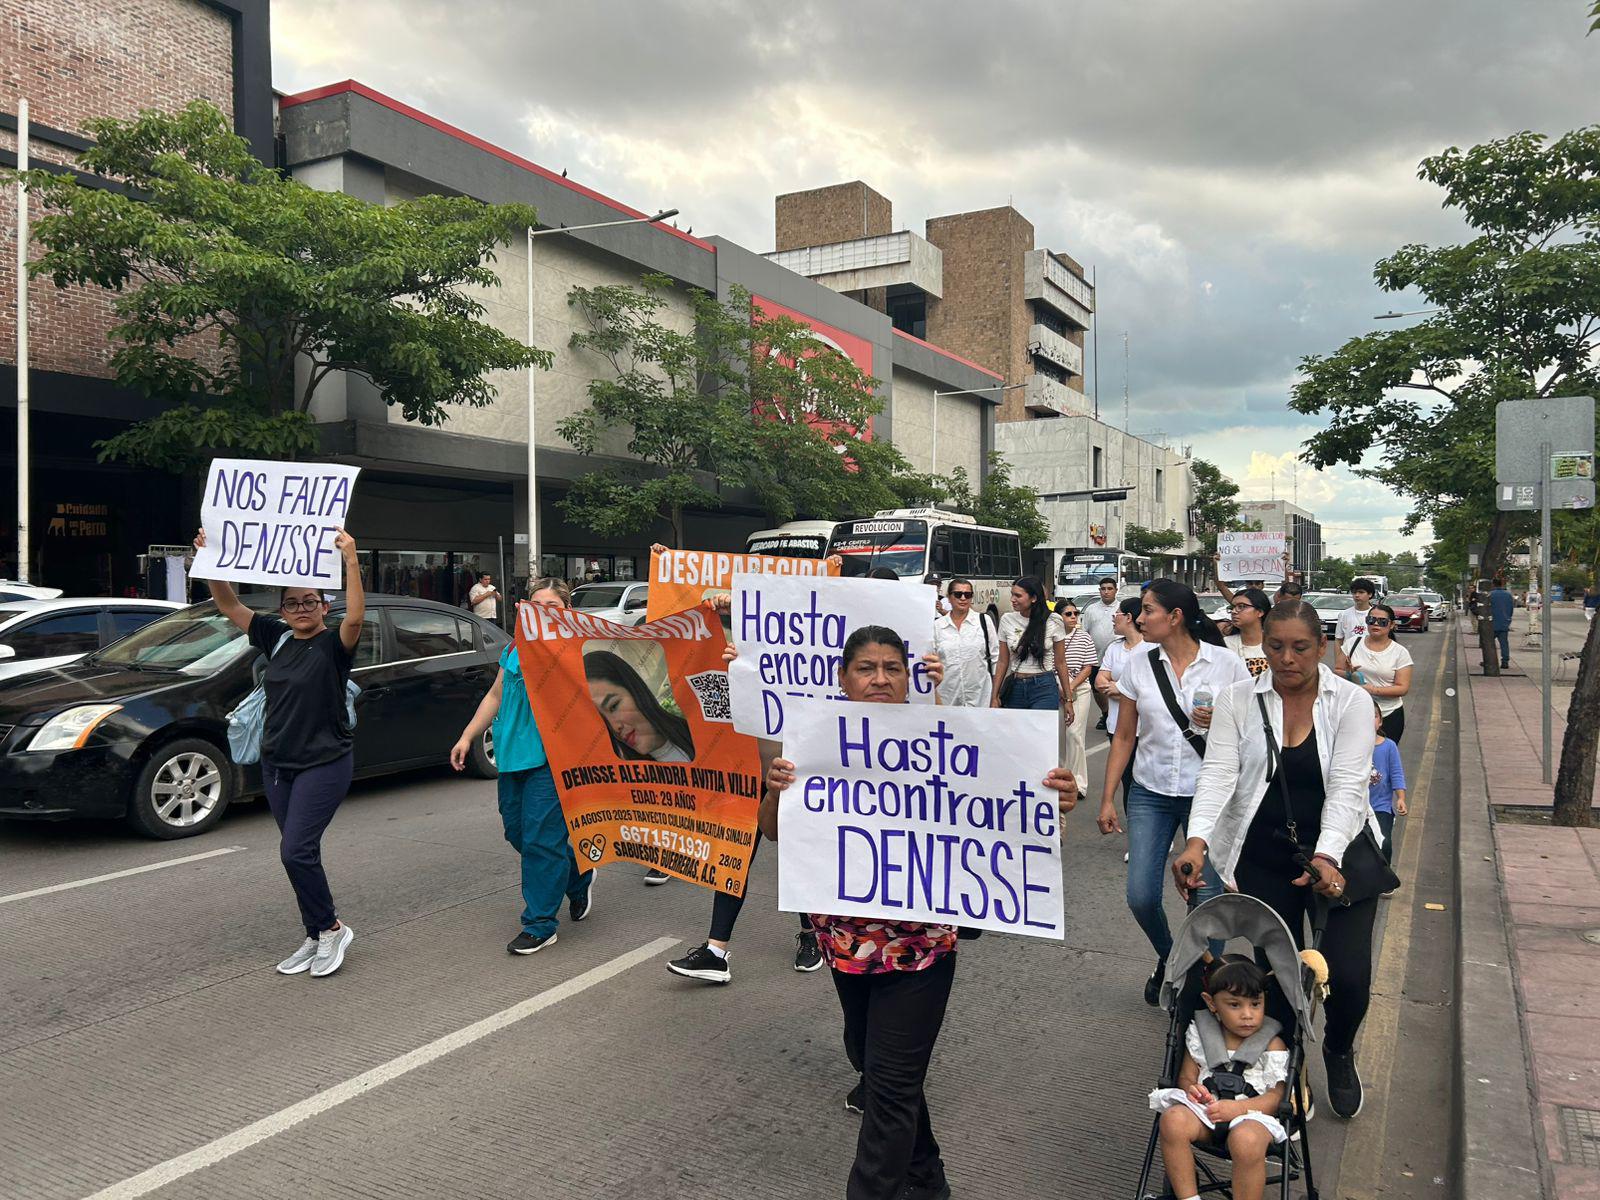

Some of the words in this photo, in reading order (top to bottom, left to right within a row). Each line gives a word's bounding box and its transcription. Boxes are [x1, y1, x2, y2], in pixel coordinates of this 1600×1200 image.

[212, 469, 267, 511] NOS
[277, 475, 349, 519] FALTA
[788, 539, 819, 550] ABASTOS
[854, 523, 902, 533] REVOLUCION
[216, 520, 337, 578] DENISSE
[1223, 562, 1232, 572] SE
[1238, 558, 1285, 573] BUSCAN
[520, 602, 713, 641] DESAPARECIDA
[741, 590, 847, 649] Hasta
[838, 715, 979, 778] Hasta
[561, 765, 618, 790] DENISSE
[618, 764, 689, 787] ALEJANDRA
[690, 767, 726, 793] AVITIA
[727, 772, 758, 799] VILLA
[630, 789, 660, 806] EDAD:
[660, 790, 673, 807] 29
[674, 789, 696, 811] AÑOS
[803, 774, 1055, 837] encontrarte
[570, 817, 580, 831] 14
[580, 809, 613, 827] AGOSTO
[612, 809, 633, 821] 2025
[632, 810, 668, 826] TRAYECTO
[668, 812, 695, 833] CULIACÁN
[695, 819, 725, 841] MAZATLÁN
[725, 827, 752, 847] SINALOA
[620, 824, 711, 861] 6671571930
[613, 841, 660, 865] SABUESOS
[660, 849, 700, 881] GUERRERAS,
[701, 863, 717, 886] A.C.
[718, 853, 743, 871] 28/08
[837, 825, 1056, 930] DENISSE
